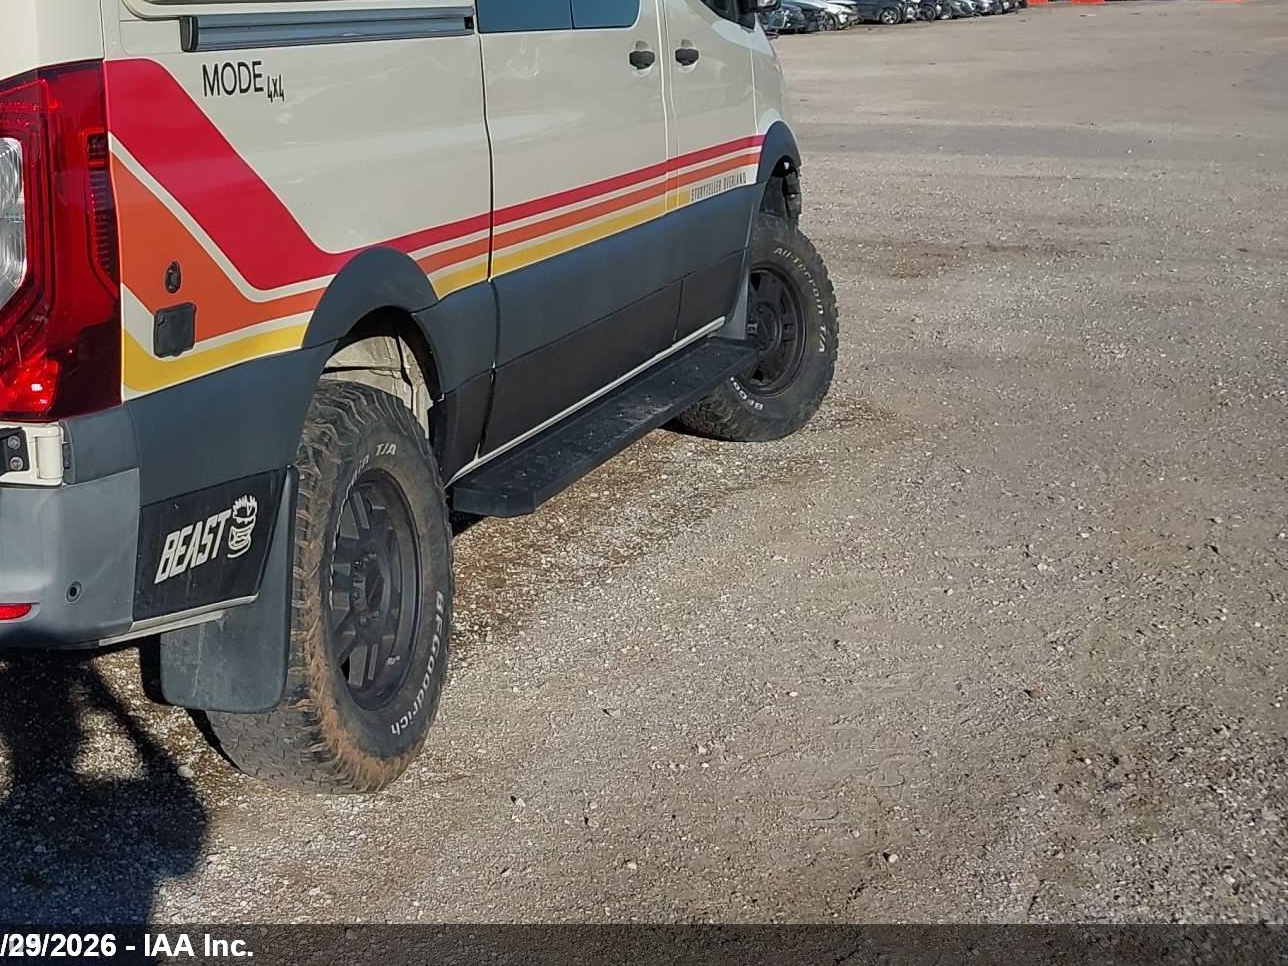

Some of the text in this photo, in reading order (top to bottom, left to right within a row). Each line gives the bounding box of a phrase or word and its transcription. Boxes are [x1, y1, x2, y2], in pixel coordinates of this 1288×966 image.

[202, 60, 265, 97] MODE
[375, 442, 397, 456] T/A
[154, 508, 233, 584] BEAST
[391, 590, 444, 736] BFGoodrich
